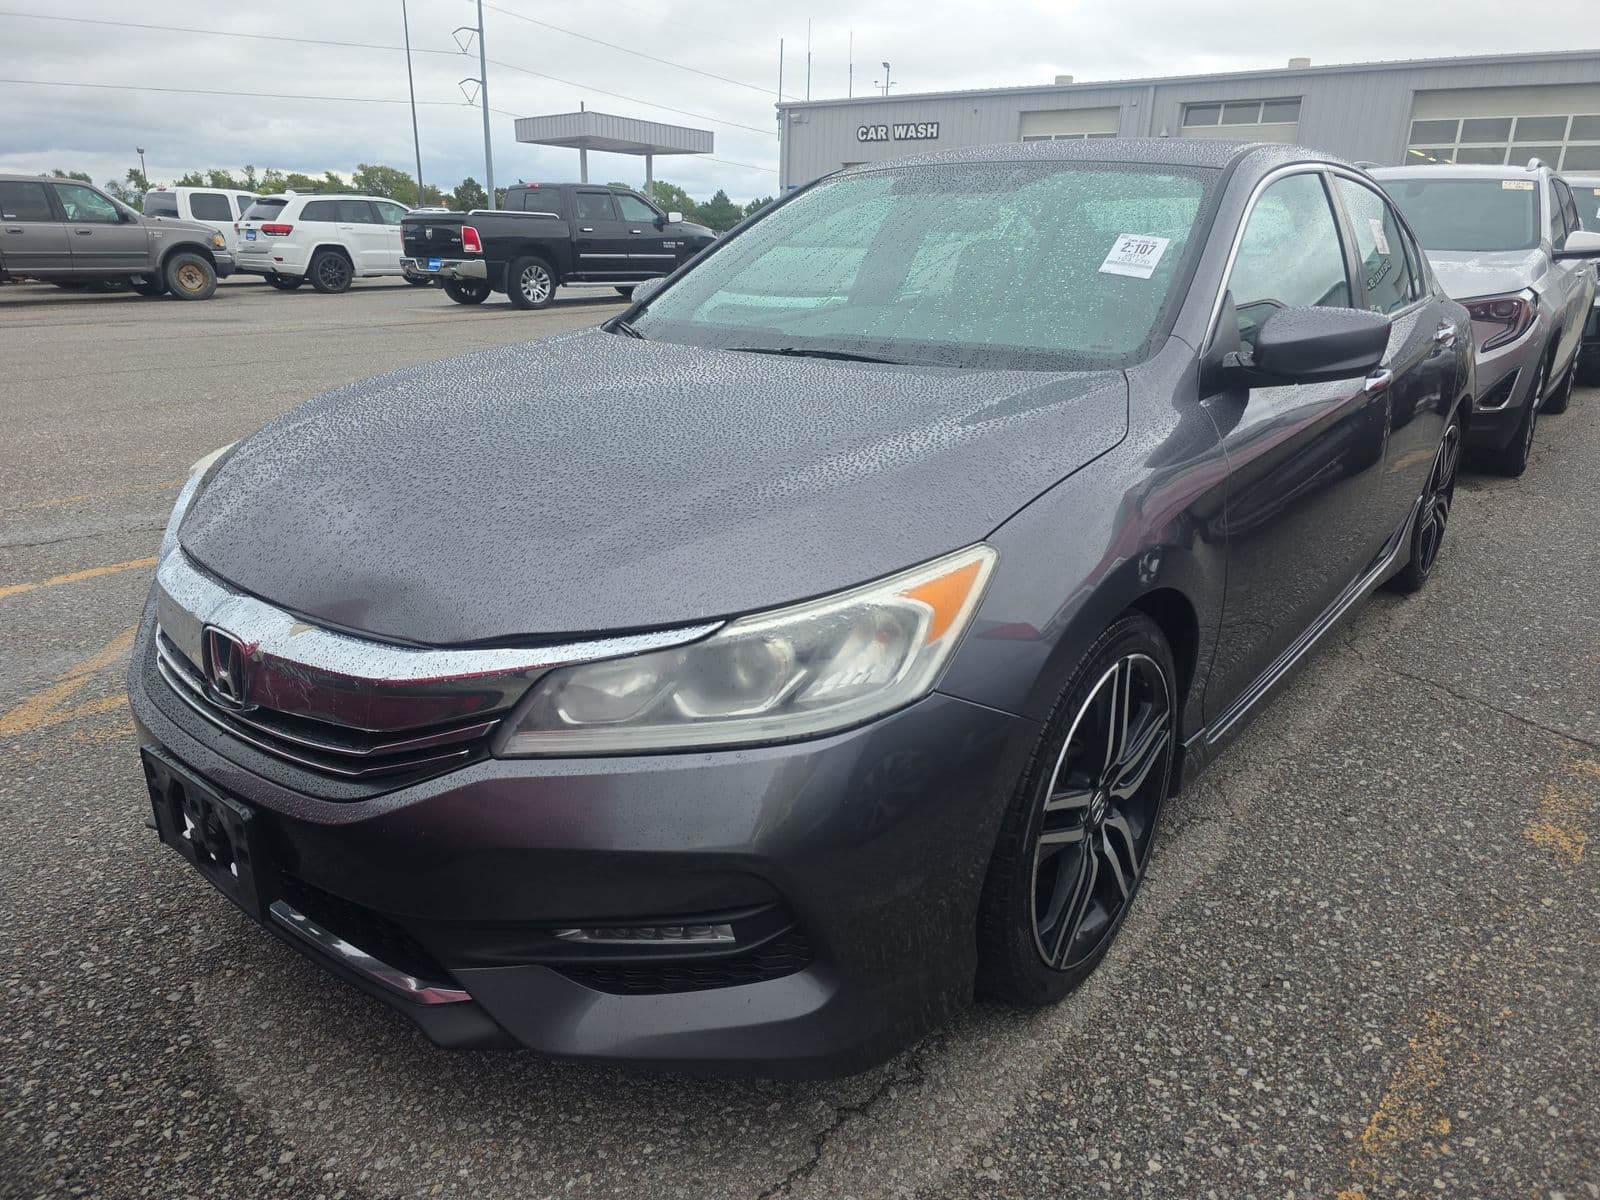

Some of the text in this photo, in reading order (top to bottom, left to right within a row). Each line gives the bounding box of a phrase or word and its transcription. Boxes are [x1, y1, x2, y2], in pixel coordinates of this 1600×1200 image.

[857, 123, 939, 141] CAR WASH
[1120, 242, 1157, 255] 2:107
